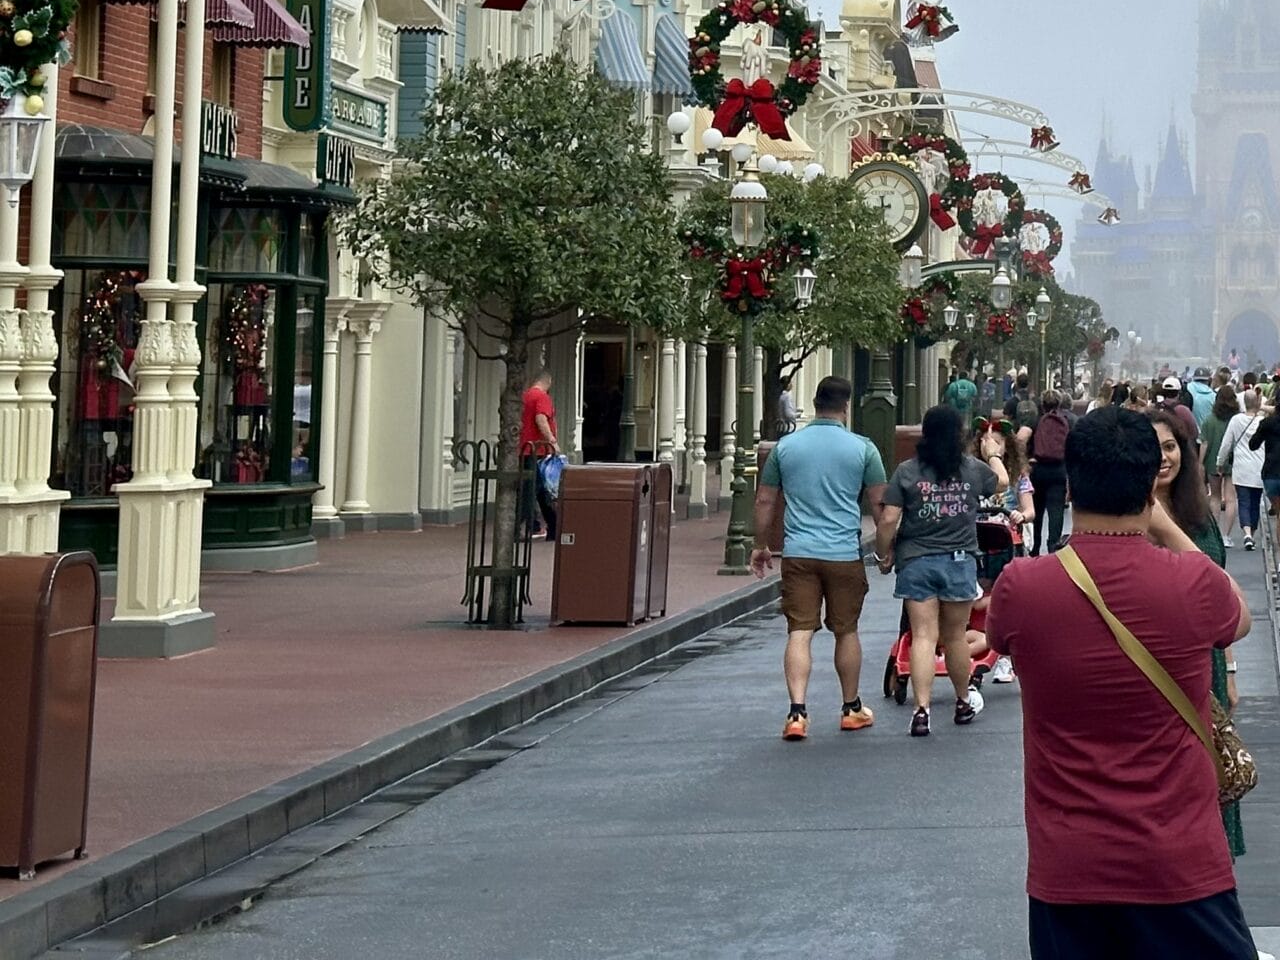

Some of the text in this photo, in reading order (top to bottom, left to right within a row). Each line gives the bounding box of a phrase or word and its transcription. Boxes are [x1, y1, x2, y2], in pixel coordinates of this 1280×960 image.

[331, 96, 380, 129] ARCADE
[917, 480, 971, 494] Believe
[931, 493, 960, 502] in the
[918, 501, 969, 518] Magic
